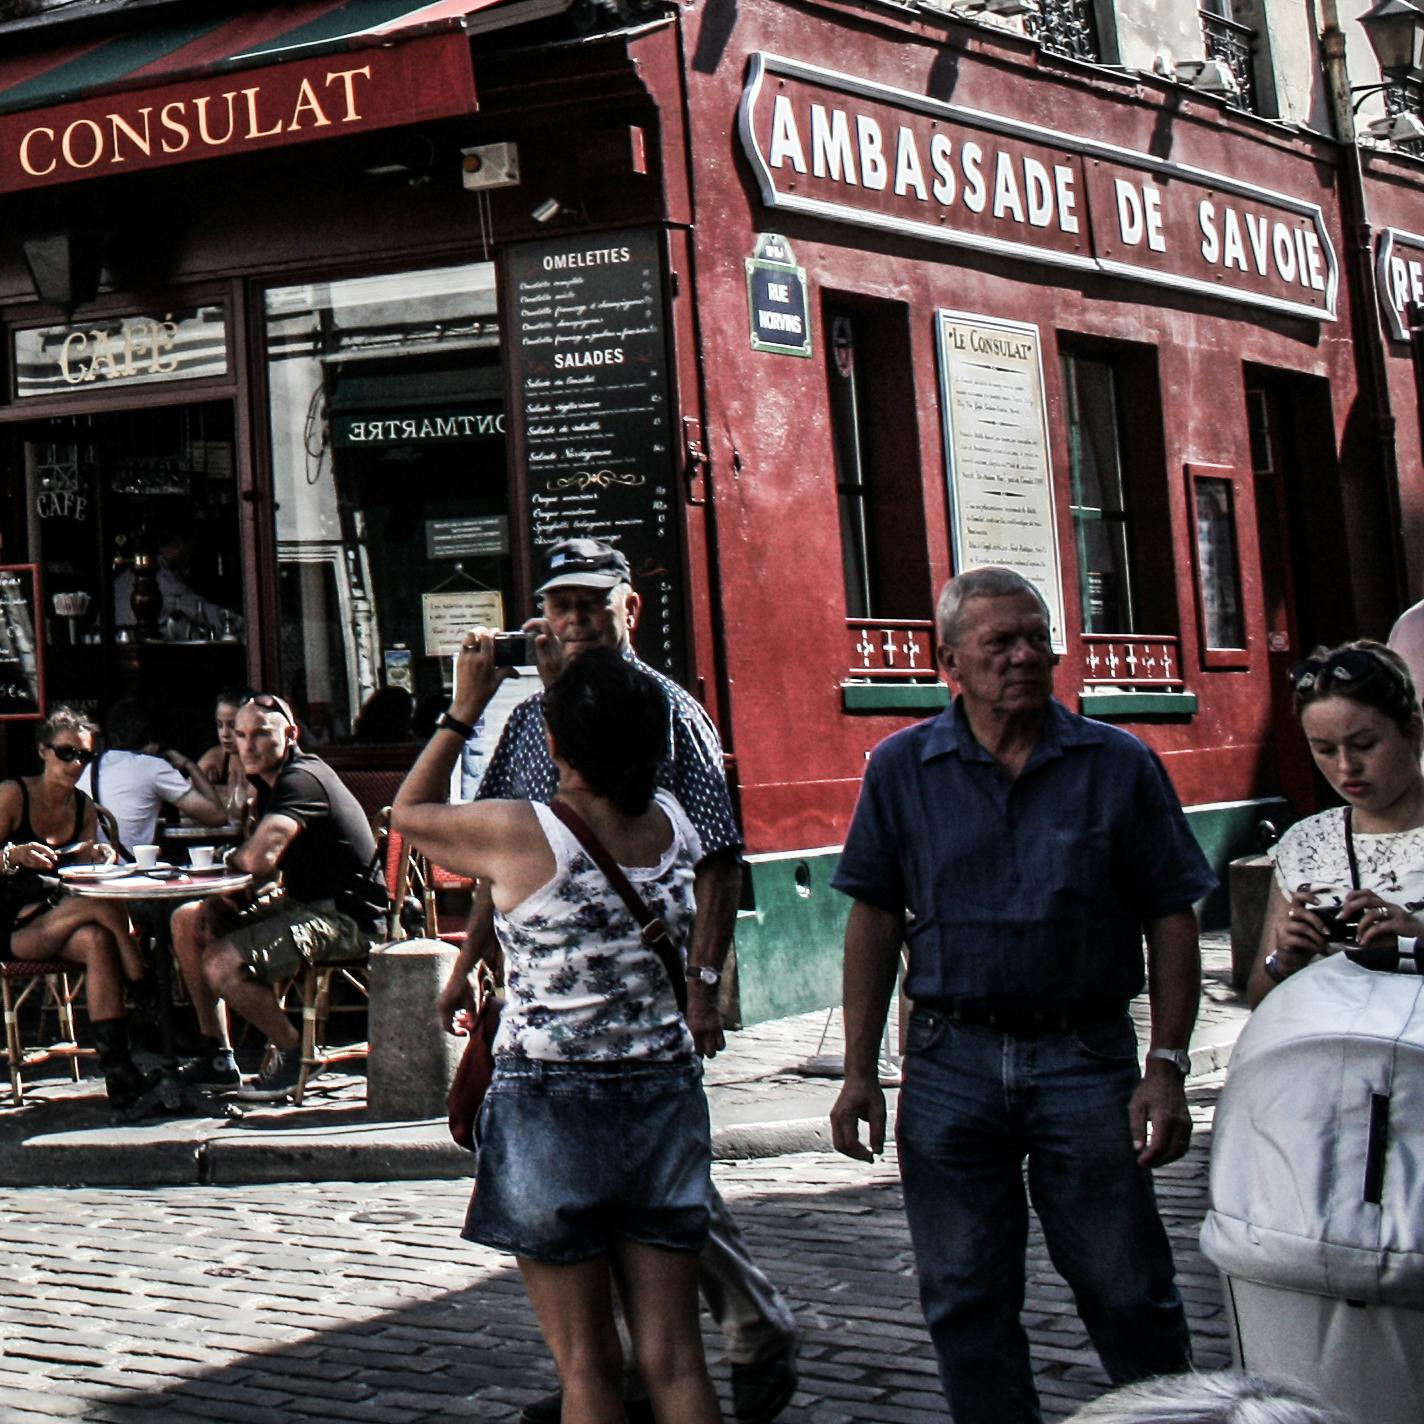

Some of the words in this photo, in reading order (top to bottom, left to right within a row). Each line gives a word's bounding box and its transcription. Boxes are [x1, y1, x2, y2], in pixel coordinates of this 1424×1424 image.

[18, 64, 373, 178] CONSULAT
[769, 95, 1080, 234] AMBASSADE
[1114, 179, 1167, 254] DE
[1199, 199, 1327, 293] SAVOIE
[543, 247, 631, 271] OMELETTES
[767, 282, 790, 304] RUE
[758, 309, 802, 334] NORVINS
[57, 312, 178, 384] CAFÉ
[554, 348, 625, 369] SALADES
